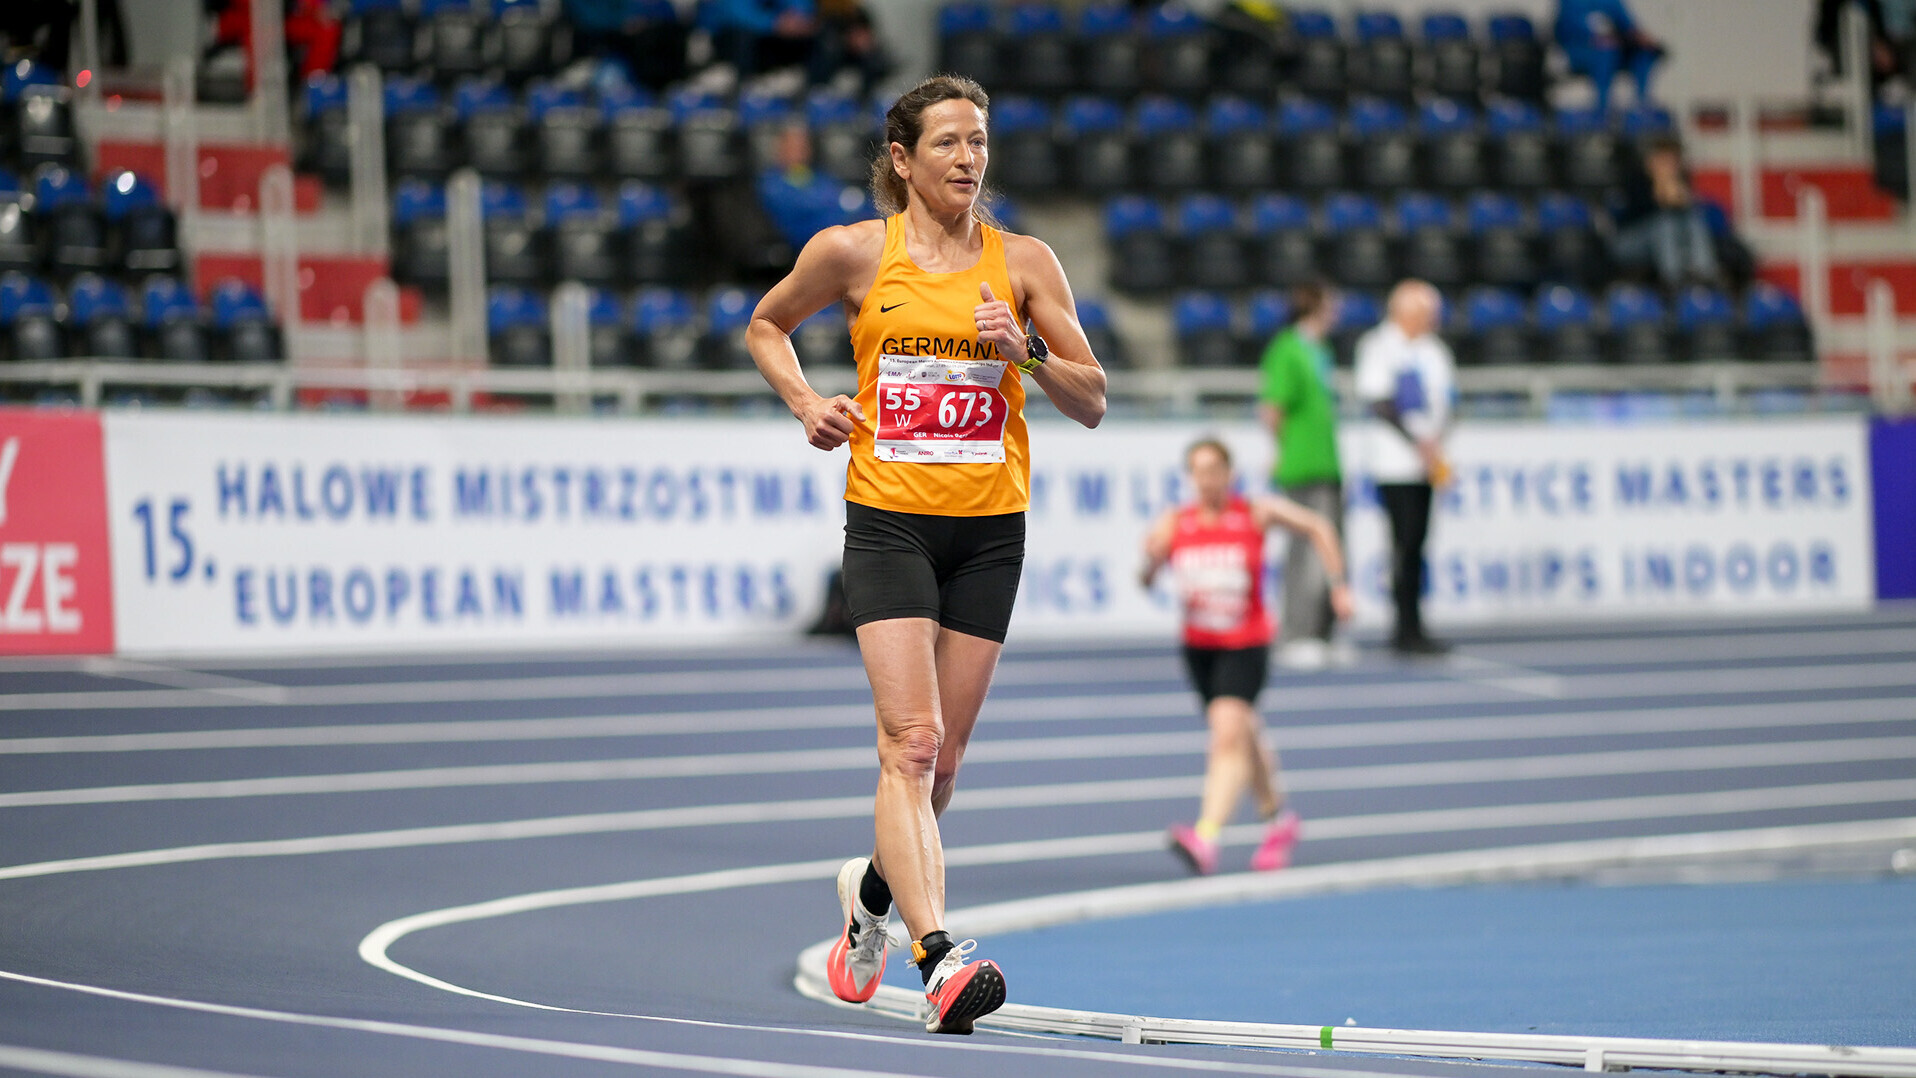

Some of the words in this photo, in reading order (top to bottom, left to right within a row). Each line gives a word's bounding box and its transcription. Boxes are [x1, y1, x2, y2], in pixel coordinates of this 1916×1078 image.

[882, 337, 999, 360] GERMAN
[885, 387, 921, 411] 55
[894, 413, 912, 427] W
[938, 391, 993, 428] 673
[215, 463, 434, 522] HALOWE
[1614, 464, 1850, 514] MASTERS
[133, 496, 216, 583] 15.
[1621, 543, 1836, 596] INDOOR
[234, 567, 522, 627] EUROPEAN
[550, 566, 795, 617] MASTERS
